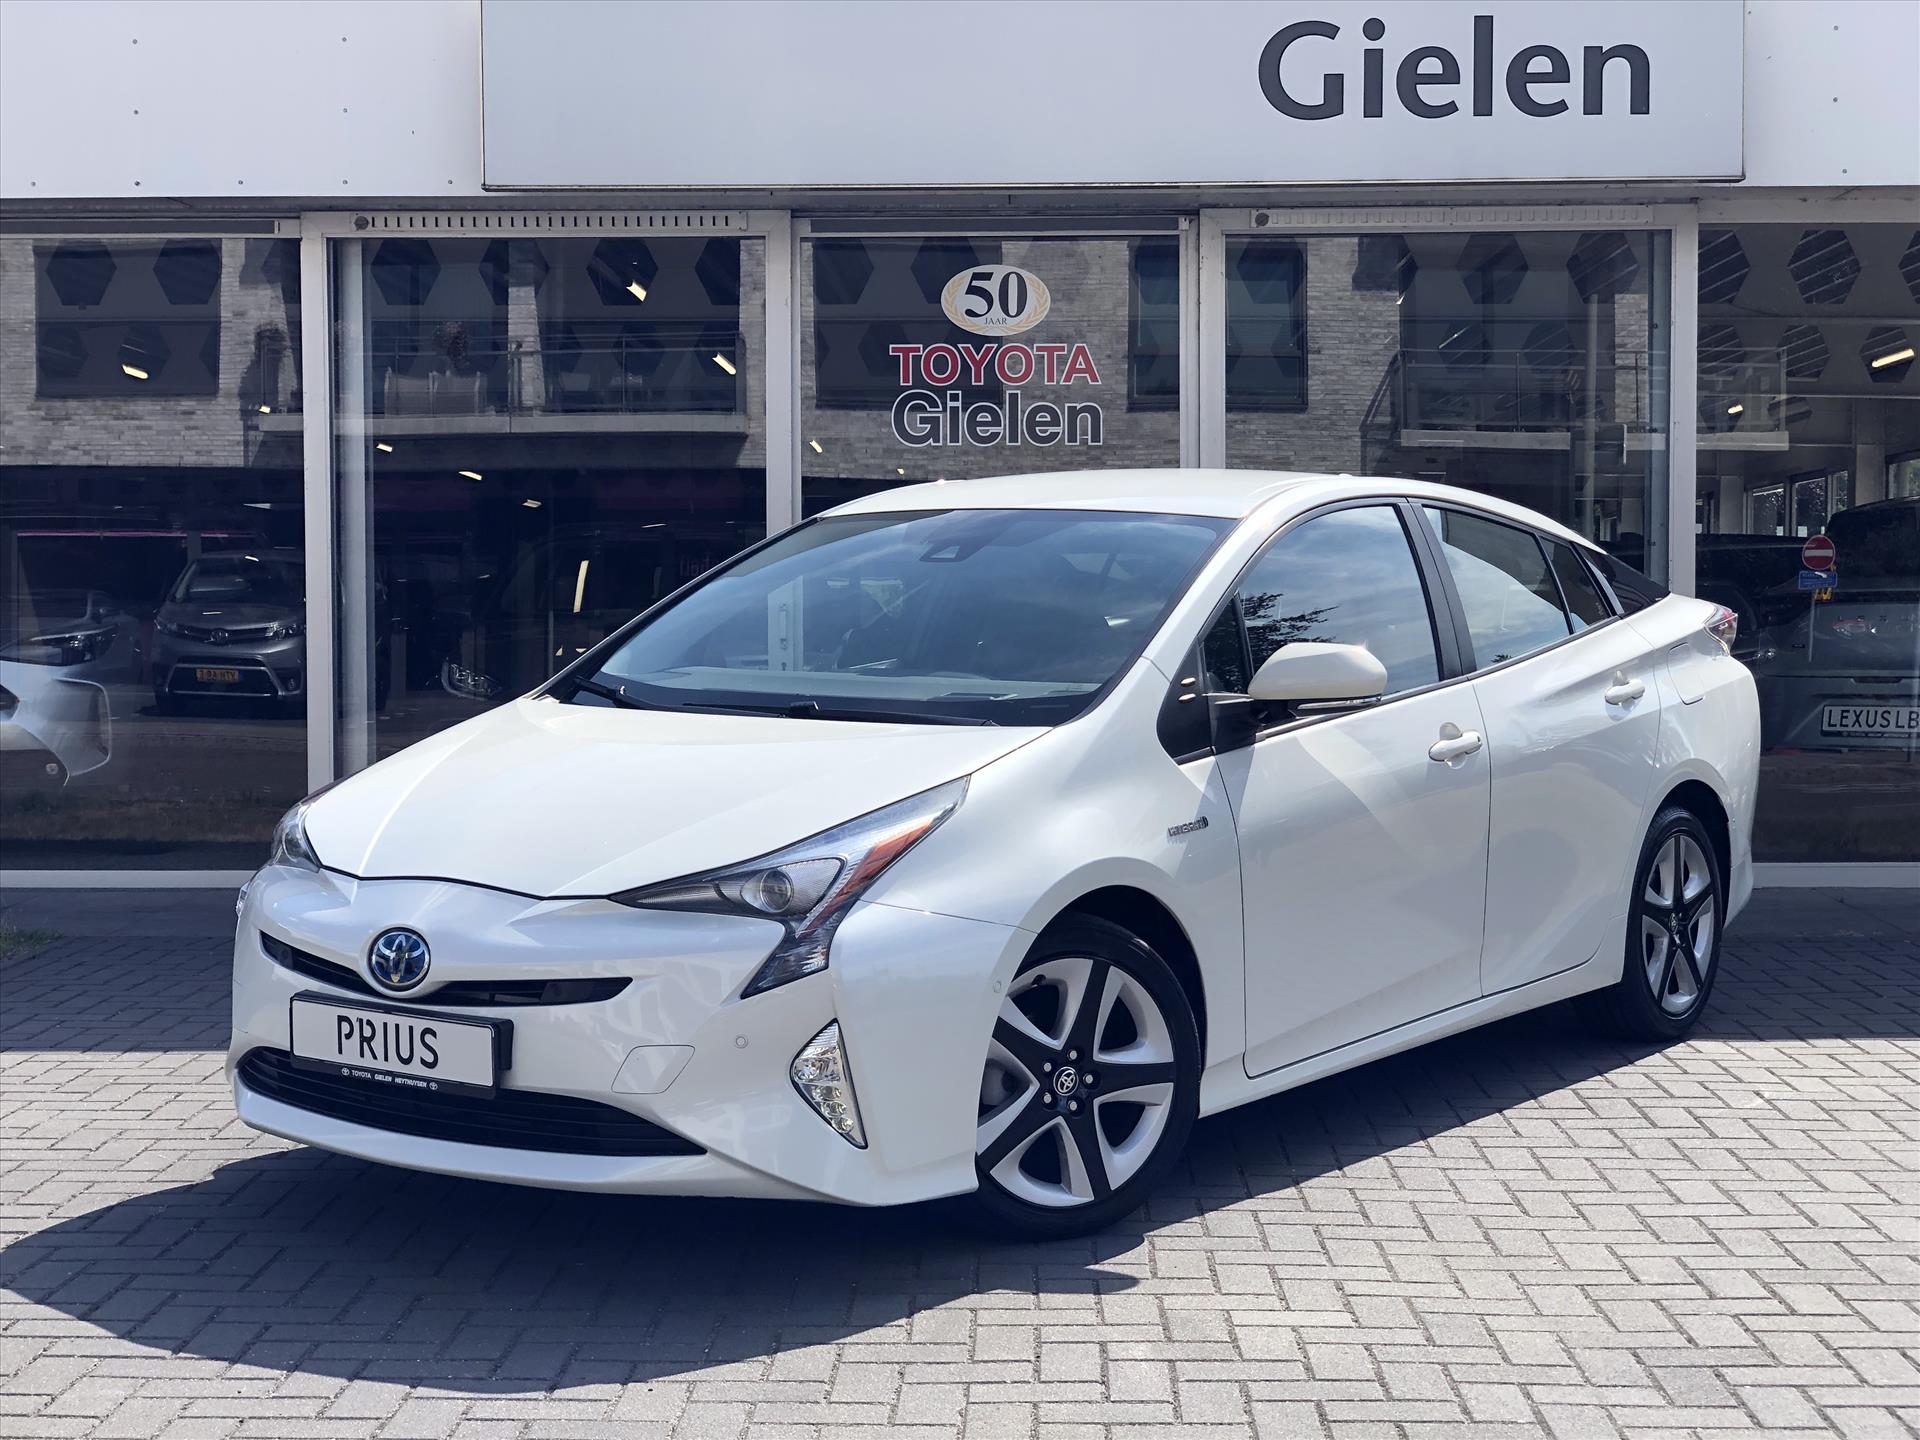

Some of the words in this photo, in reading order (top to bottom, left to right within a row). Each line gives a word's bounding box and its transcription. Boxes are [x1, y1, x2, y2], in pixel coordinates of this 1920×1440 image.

[1258, 15, 1650, 120] Gielen
[964, 271, 1028, 318] 50
[984, 317, 1008, 325] JAAR
[889, 343, 1102, 386] TOYOTA
[891, 389, 1103, 447] Gielen
[337, 1015, 439, 1069] PRIUS
[352, 1070, 371, 1079] TOYOTA
